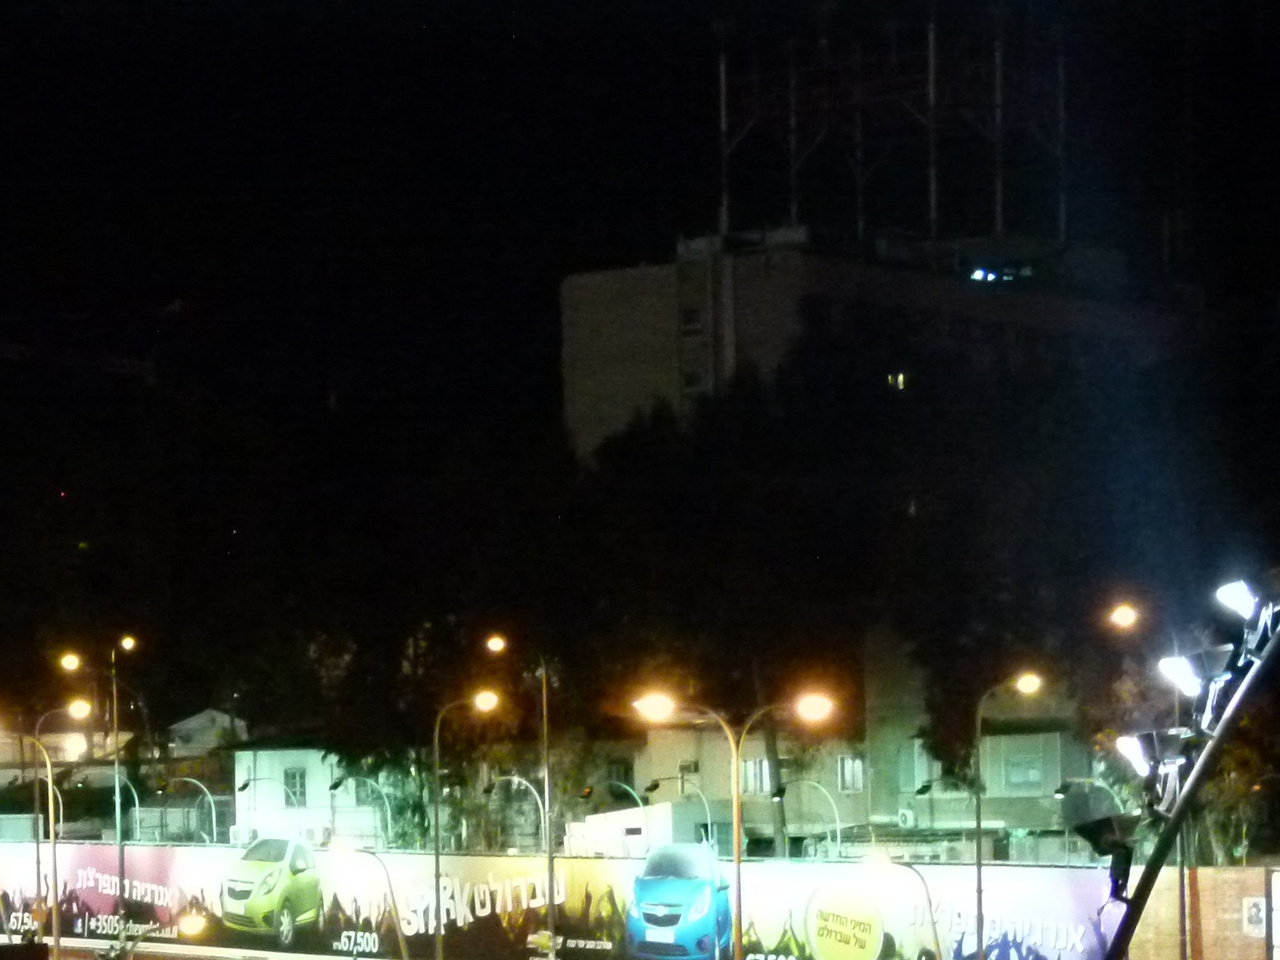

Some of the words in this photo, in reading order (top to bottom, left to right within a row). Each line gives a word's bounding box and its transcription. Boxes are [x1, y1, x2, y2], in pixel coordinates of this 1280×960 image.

[474, 869, 566, 917] שברולט
[340, 930, 379, 955] 67,500
[853, 931, 867, 950] של
